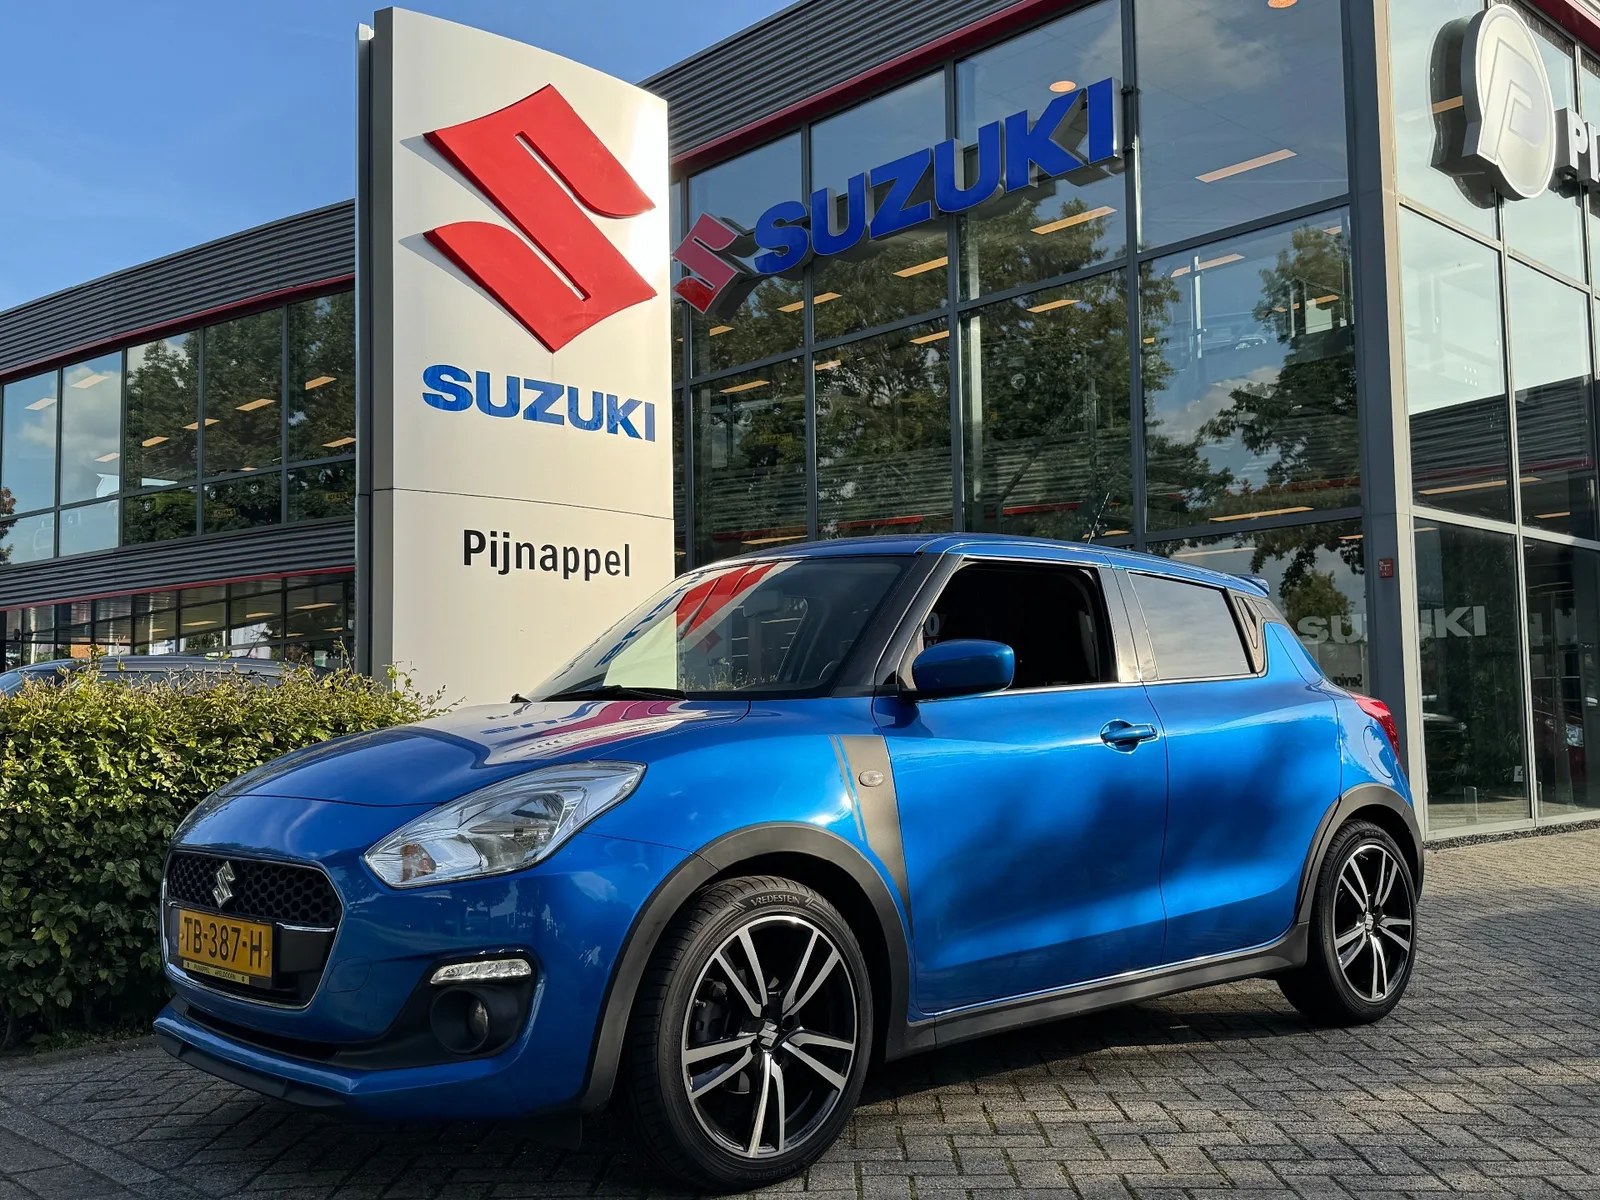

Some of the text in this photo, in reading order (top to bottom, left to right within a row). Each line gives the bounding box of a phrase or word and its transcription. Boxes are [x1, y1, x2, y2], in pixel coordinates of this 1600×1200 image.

[753, 77, 1117, 275] SUZUKI
[1566, 107, 1600, 183] PI
[422, 364, 656, 443] SUZUKI
[463, 528, 631, 582] Pijnappel
[183, 915, 264, 969] TB-387-H
